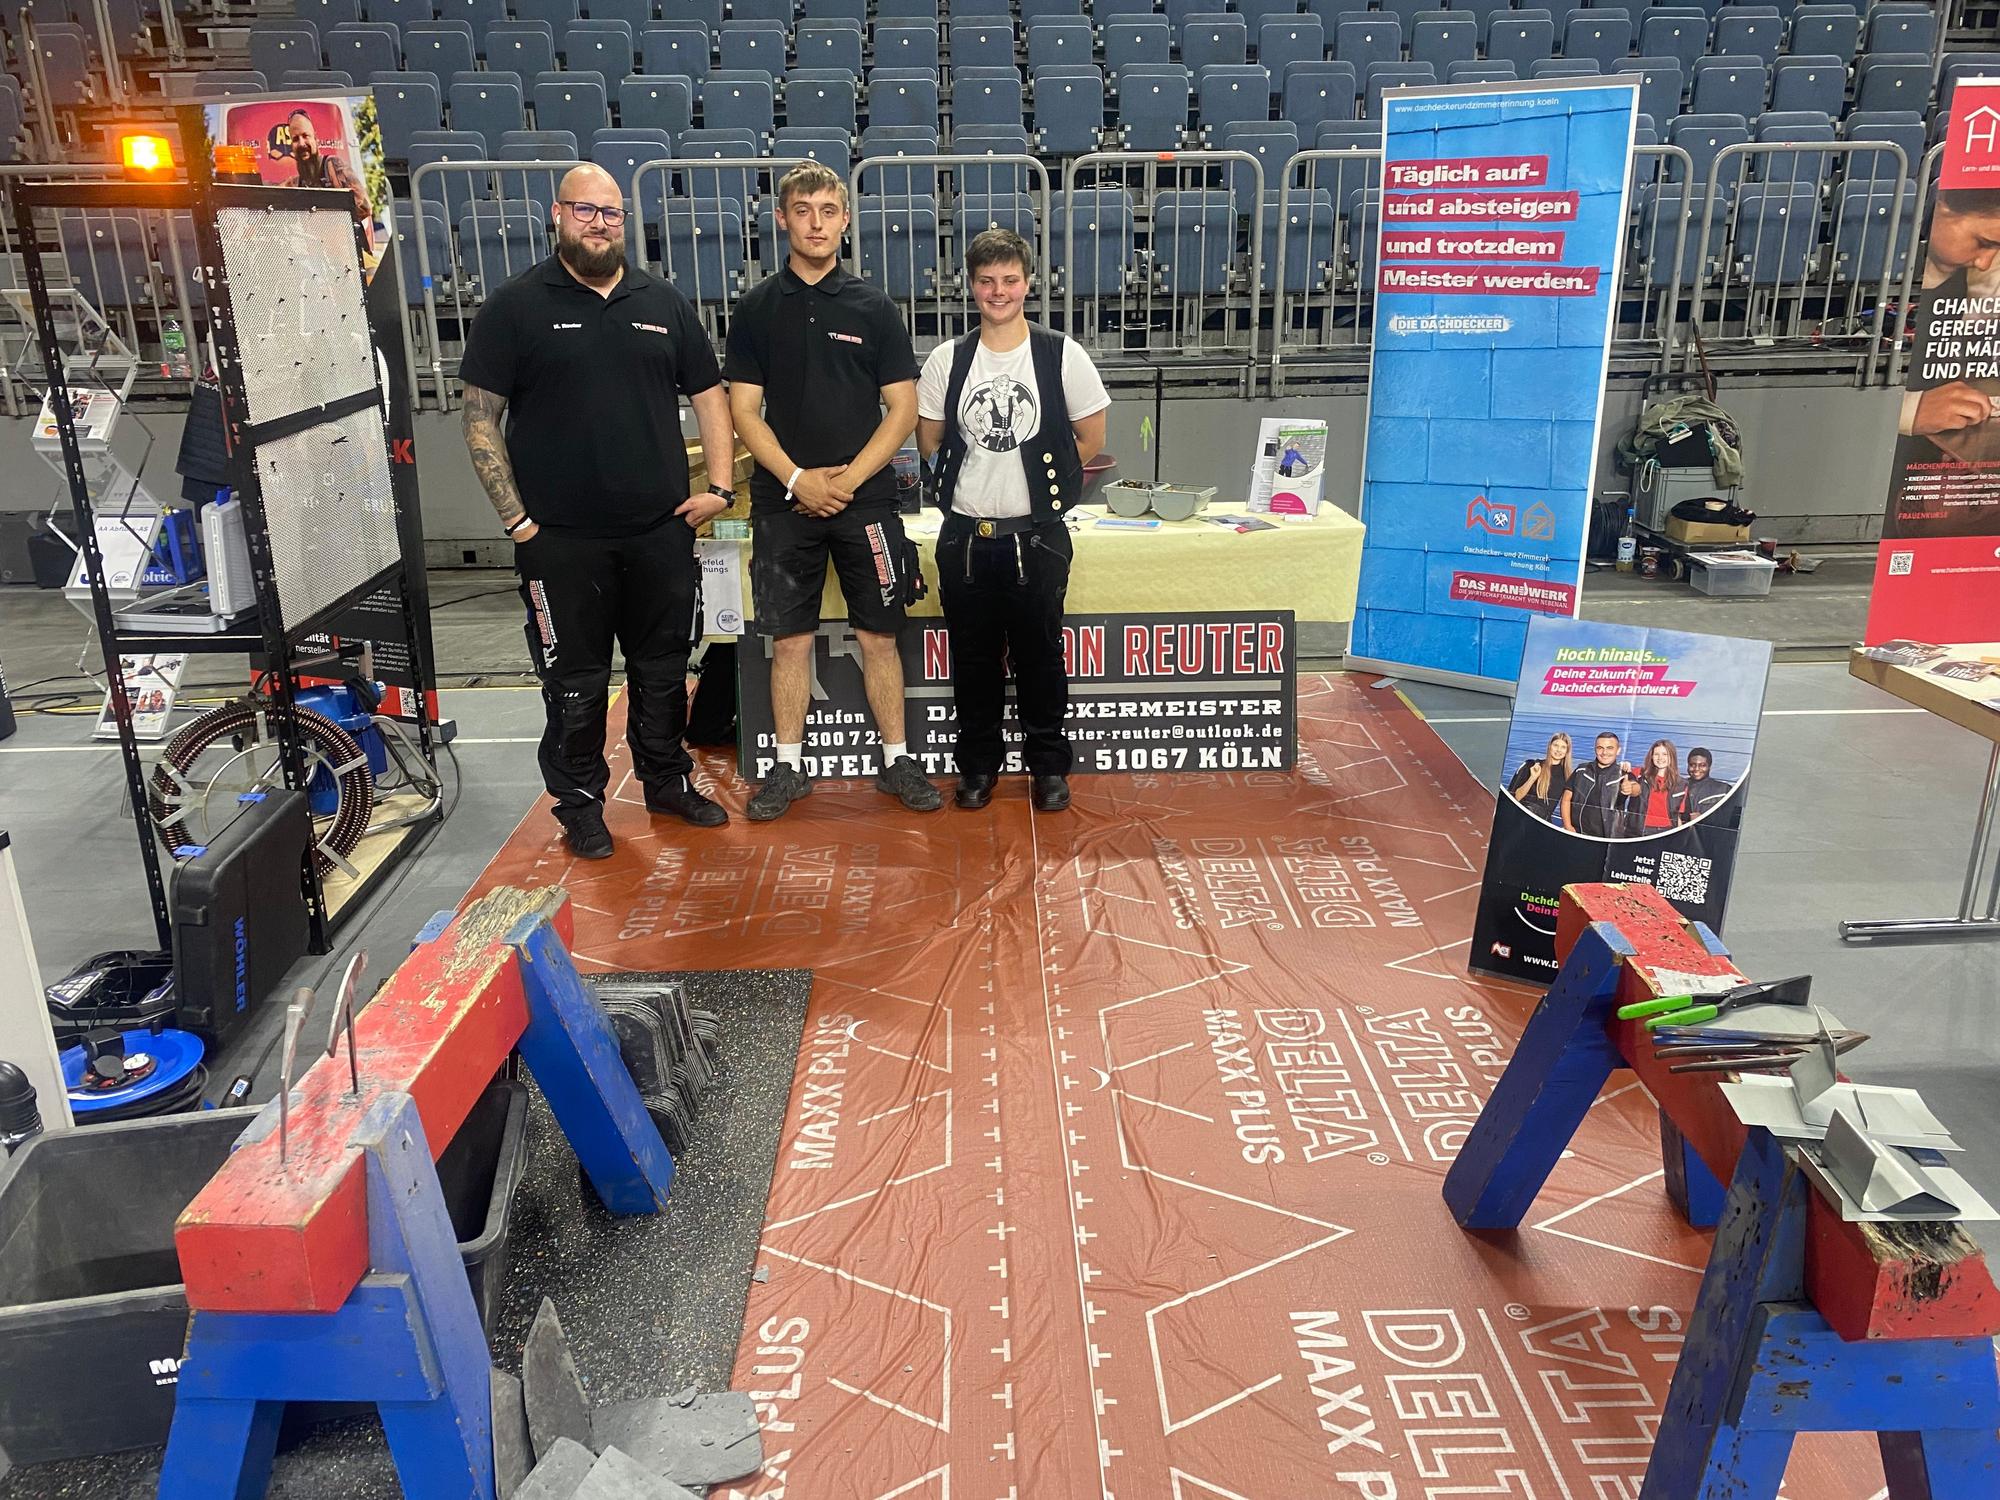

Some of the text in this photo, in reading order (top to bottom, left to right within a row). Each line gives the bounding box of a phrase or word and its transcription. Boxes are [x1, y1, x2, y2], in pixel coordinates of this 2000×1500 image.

[1391, 163, 1539, 186] Täglich auf-
[1388, 197, 1571, 218] und absteigen
[1386, 238, 1556, 255] und trotzdem
[1384, 270, 1590, 290] Meister werden.
[1397, 317, 1503, 329] DIE DACHDECKER
[1929, 319, 2000, 336] GERECH
[1925, 337, 1961, 358] FÜR
[1922, 361, 2000, 379] UND FRA
[1503, 551, 1517, 559] und
[702, 566, 729, 574] hungs
[1510, 561, 1550, 571] Innung Köln
[142, 570, 170, 582] olvic
[1459, 578, 1568, 602] DAS HANDWERK
[1123, 621, 1285, 677] REUTER
[1556, 648, 1667, 663] Hoch hinaus...
[1553, 668, 1654, 681] Deine Zukunft im
[1550, 681, 1680, 696] Dachdeckerhandwerk
[805, 709, 865, 725] elefon
[757, 731, 844, 748] 01-300
[848, 730, 861, 746] 7
[1095, 747, 1188, 770] 51067
[1198, 742, 1282, 768] KÖLN
[1633, 855, 1655, 865] Jetzt
[1610, 870, 1652, 884] Lehrstelle
[1636, 865, 1654, 875] hier
[1341, 836, 1424, 928] MAXX PLUS
[1520, 892, 1560, 907] Dachde
[1526, 903, 1551, 915] Dein
[234, 915, 247, 1013] WÖHLER
[1523, 954, 1559, 969] www.D
[1444, 1005, 1511, 1067] PLUS
[790, 1014, 857, 1170] MAXX PLUS
[1202, 1008, 1286, 1165] MAXX PLUS
[1254, 1007, 1379, 1163] DELTA
[749, 1315, 811, 1433] PLUS
[1289, 1311, 1385, 1455] MAXX
